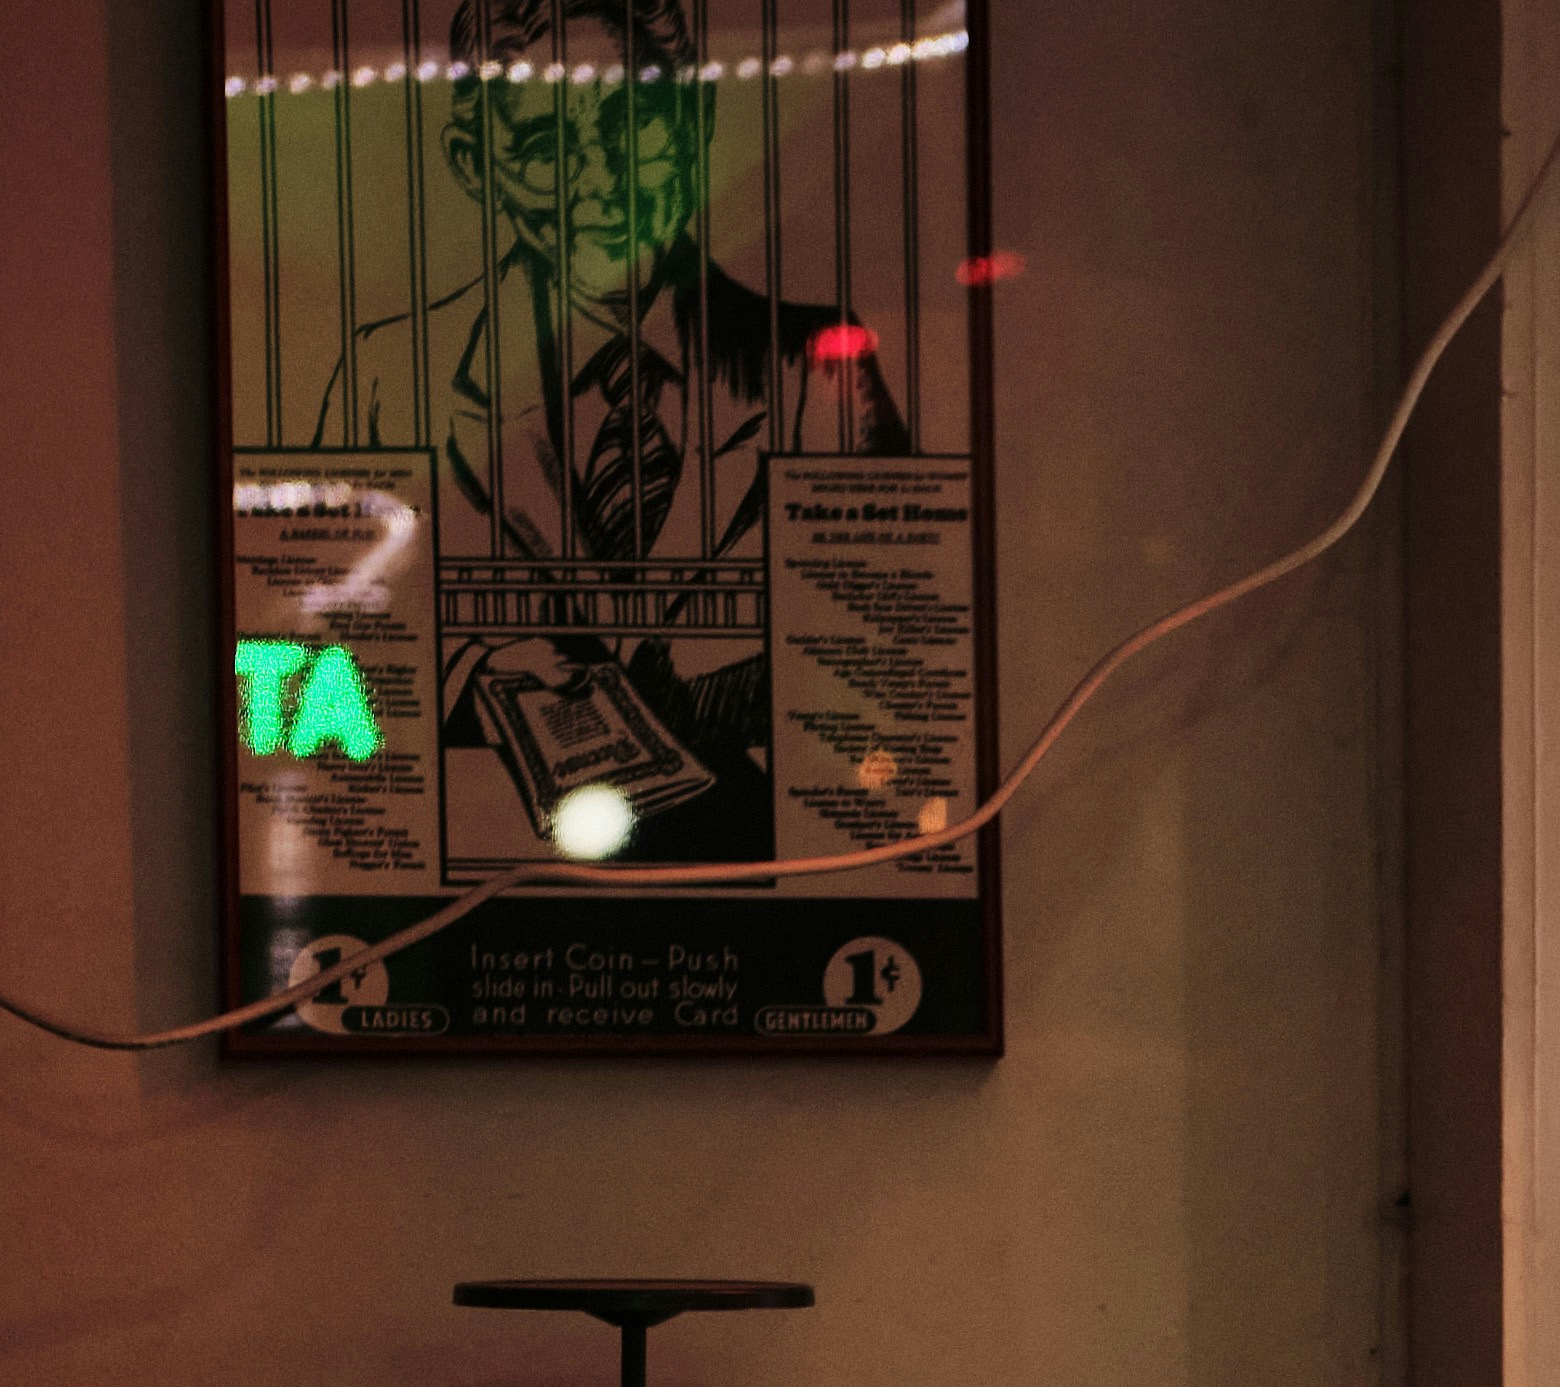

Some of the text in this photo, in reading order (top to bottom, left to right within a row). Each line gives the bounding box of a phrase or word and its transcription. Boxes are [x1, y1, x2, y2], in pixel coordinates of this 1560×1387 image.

[785, 503, 843, 521] Take
[846, 508, 858, 521] a
[903, 504, 967, 522] Home
[470, 943, 739, 972] Insert Coin Push
[471, 974, 526, 999] slide
[567, 975, 614, 999] Pull
[620, 976, 660, 999] out
[668, 974, 739, 1004] slowly
[843, 949, 901, 1006] 1¢
[359, 1010, 433, 1030] LADIES
[471, 1003, 739, 1026] and receive Card
[765, 1010, 868, 1030] GENTLEMEN
